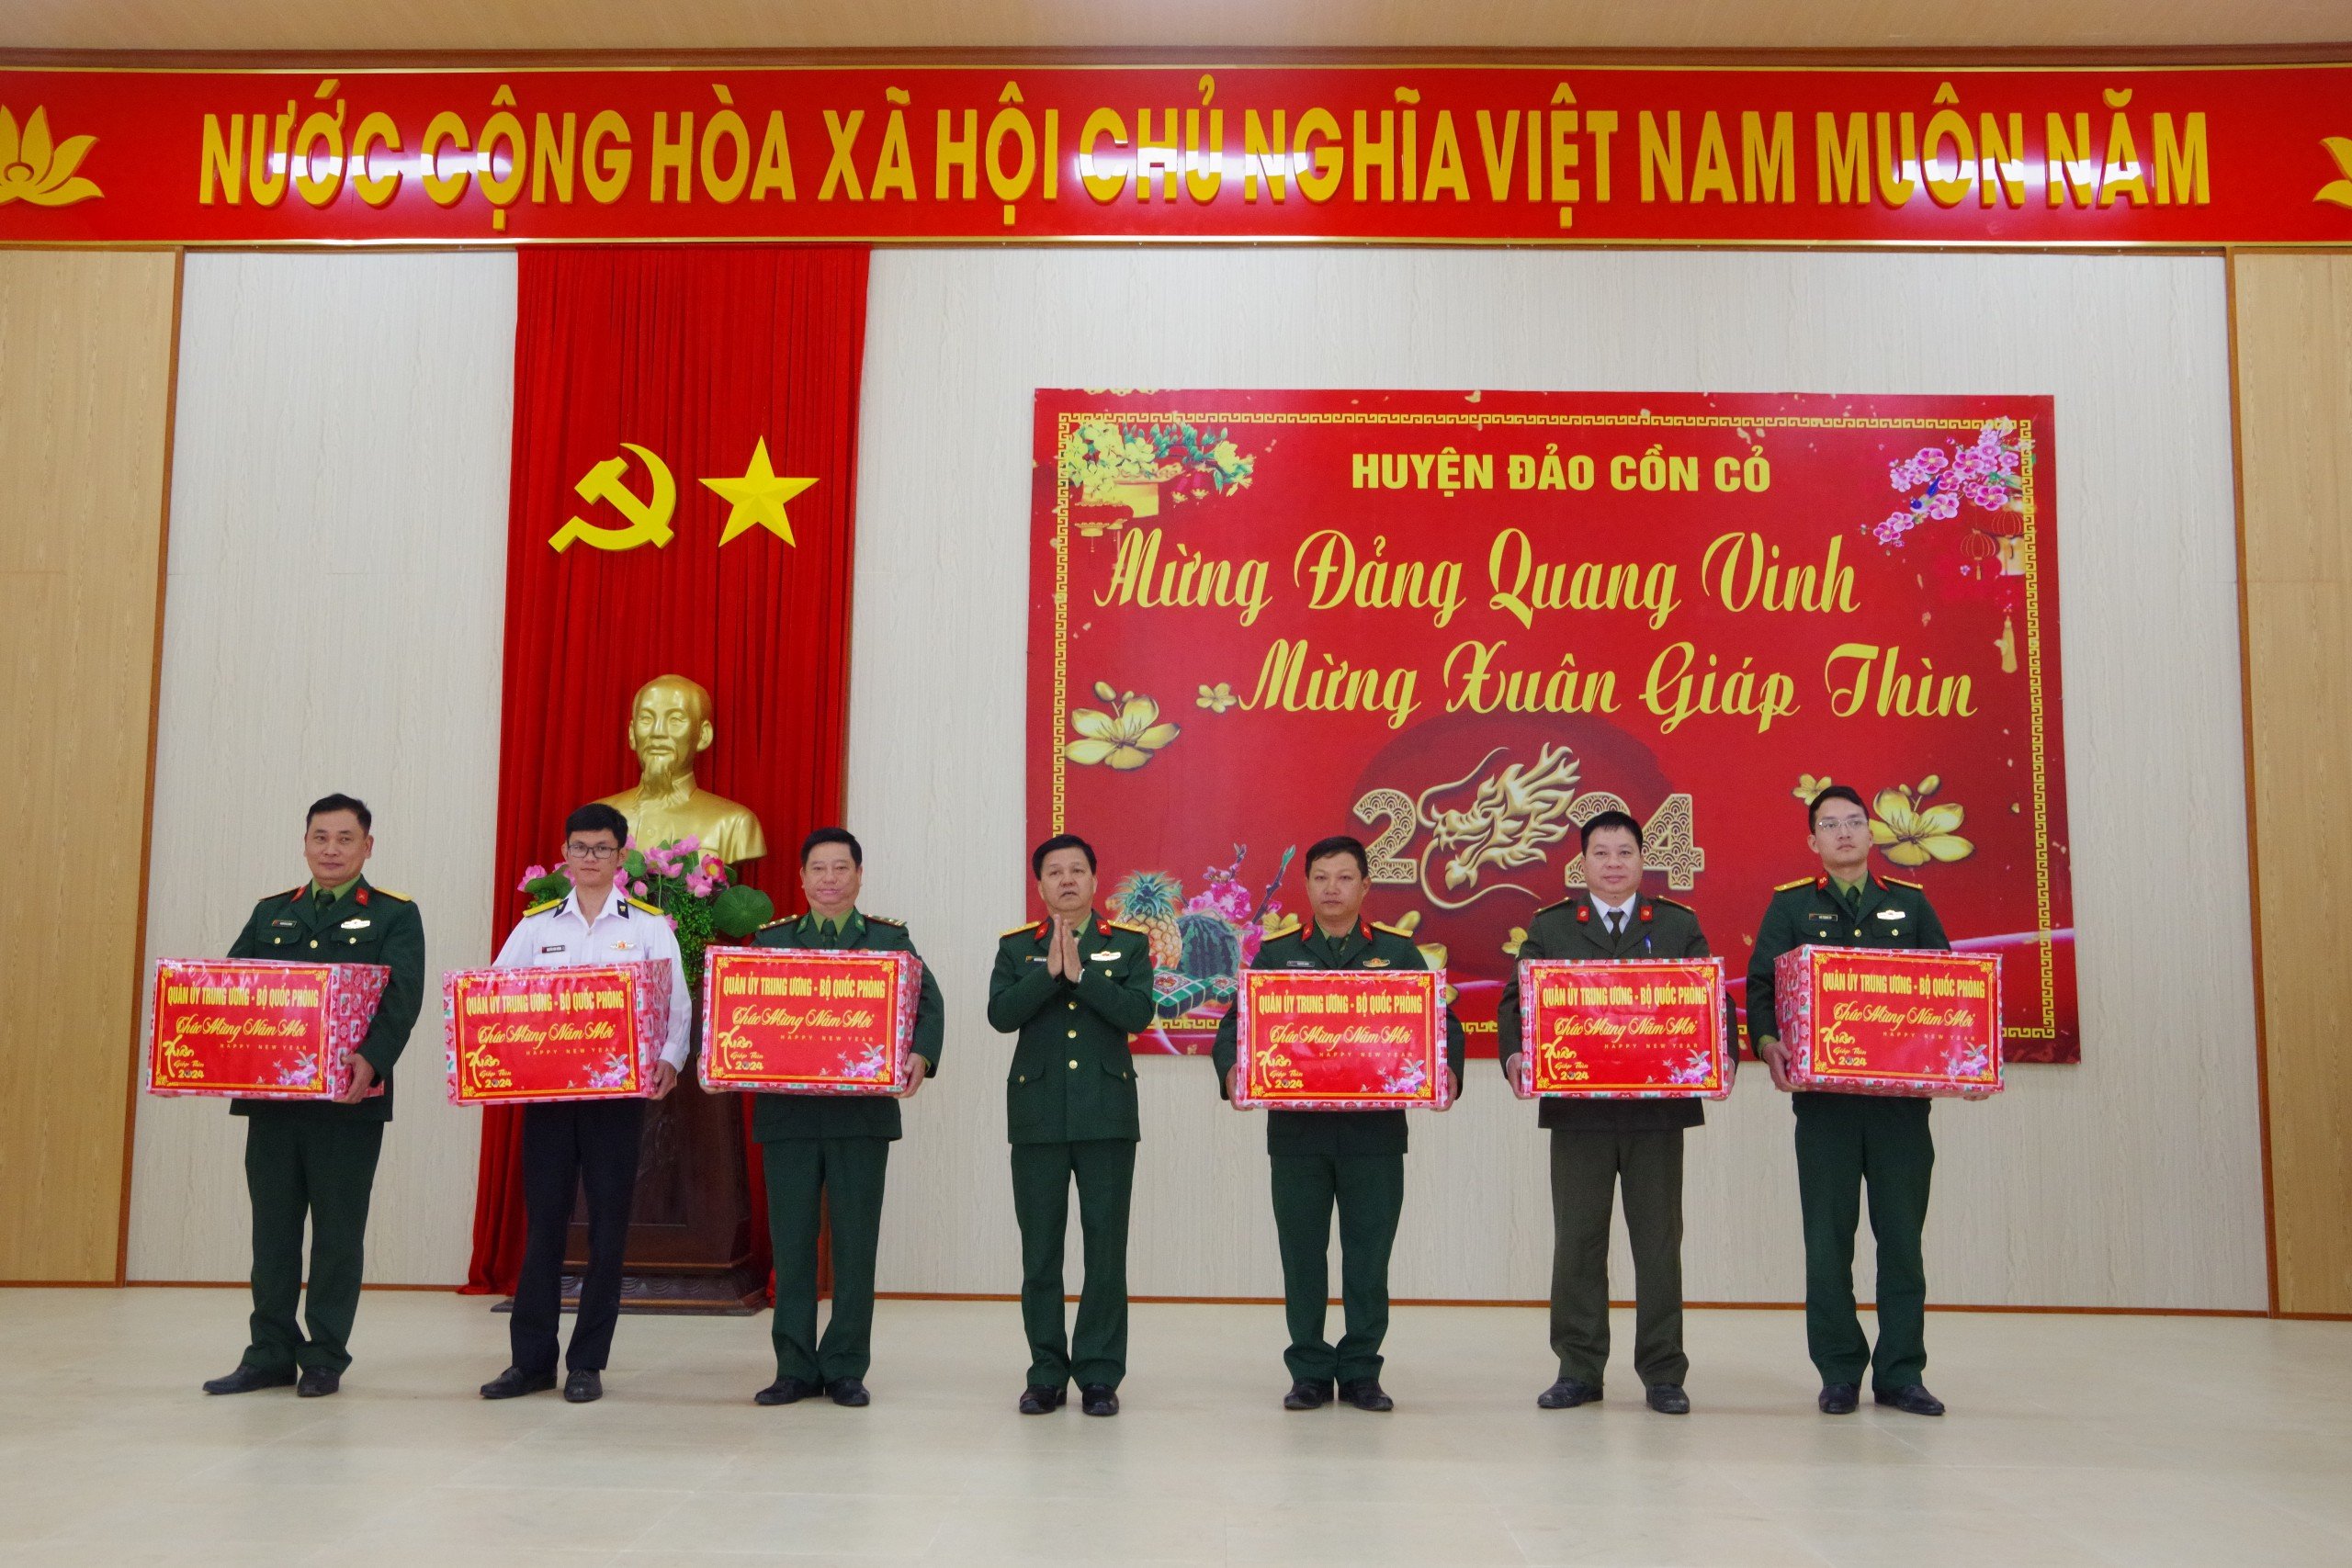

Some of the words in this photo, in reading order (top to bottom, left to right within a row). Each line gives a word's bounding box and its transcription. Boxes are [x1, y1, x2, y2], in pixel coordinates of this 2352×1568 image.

[199, 79, 404, 208] NƯỚC
[420, 85, 632, 231] CỘNG
[650, 83, 797, 204] HÒA
[819, 86, 917, 202] XÃ
[934, 81, 1059, 226] HỘI
[1078, 73, 1224, 204] CHỦ
[1245, 85, 1471, 203] NGHĨA
[1476, 82, 1618, 228] VIỆT
[1640, 109, 1795, 204] NAM
[1815, 81, 2024, 209] MUÔN
[2045, 87, 2211, 209] NĂM
[1352, 446, 1494, 497] HUYỆN
[1508, 444, 1594, 491] ĐẢO
[1611, 445, 1700, 491] CỒN
[1714, 446, 1770, 492] CỎ
[1093, 527, 1273, 627] Mừng
[1294, 529, 1467, 628] Đảng
[1488, 527, 1681, 630] Quang
[1702, 532, 1860, 613] Vinh
[1238, 638, 1421, 729] Mừng
[1443, 640, 1621, 713] Xuân
[1639, 641, 1801, 735] Giáp
[1825, 642, 1977, 717] Thìn
[167, 983, 188, 1006] QUÂN
[189, 981, 200, 1005] ỦY
[201, 987, 227, 1005] TRUNG
[256, 985, 267, 1010] BỘ
[269, 982, 290, 1009] QUỐC
[291, 985, 319, 1007] PHÒNG
[723, 972, 746, 997] QUÂN
[747, 971, 759, 995] ỦY
[760, 977, 787, 996] TRUNG
[819, 975, 831, 1001] BỘ
[832, 973, 855, 999] QUỐC
[857, 976, 886, 998] PHÒNG
[1543, 984, 1566, 1008] QUÂN
[1567, 982, 1578, 1006] ỦY
[1580, 987, 1608, 1006] TRUNG
[1640, 983, 1652, 1010] BỘ
[1654, 981, 1677, 1007] QUỐC
[1678, 982, 1707, 1005] PHÒNG
[1823, 968, 1845, 993] QUÂN
[1848, 967, 1858, 992] ỦY
[1860, 974, 1887, 993] TRUNG
[1919, 974, 1931, 999] BỘ
[1933, 972, 1955, 998] QUỐC
[1957, 975, 1985, 998] PHÒNG
[466, 992, 488, 1017] QUÂN
[489, 989, 501, 1014] ỦY
[502, 994, 528, 1013] TRUNG
[559, 988, 571, 1015] BỘ
[572, 986, 594, 1012] QUỐC
[596, 986, 624, 1010] PHÒNG
[1259, 991, 1282, 1015] QUÂN
[1283, 989, 1295, 1013] ỦY
[1296, 995, 1323, 1013] TRUNG
[1356, 991, 1367, 1018] BỘ
[1370, 989, 1392, 1015] QUỐC
[1394, 991, 1422, 1013] PHÒNG
[1906, 1007, 1944, 1025] Năm
[243, 1018, 278, 1036] Năm
[548, 1022, 585, 1041] Năm
[805, 1009, 842, 1027] Năm
[1628, 1017, 1666, 1034] Năm
[1343, 1026, 1381, 1043] Năm
